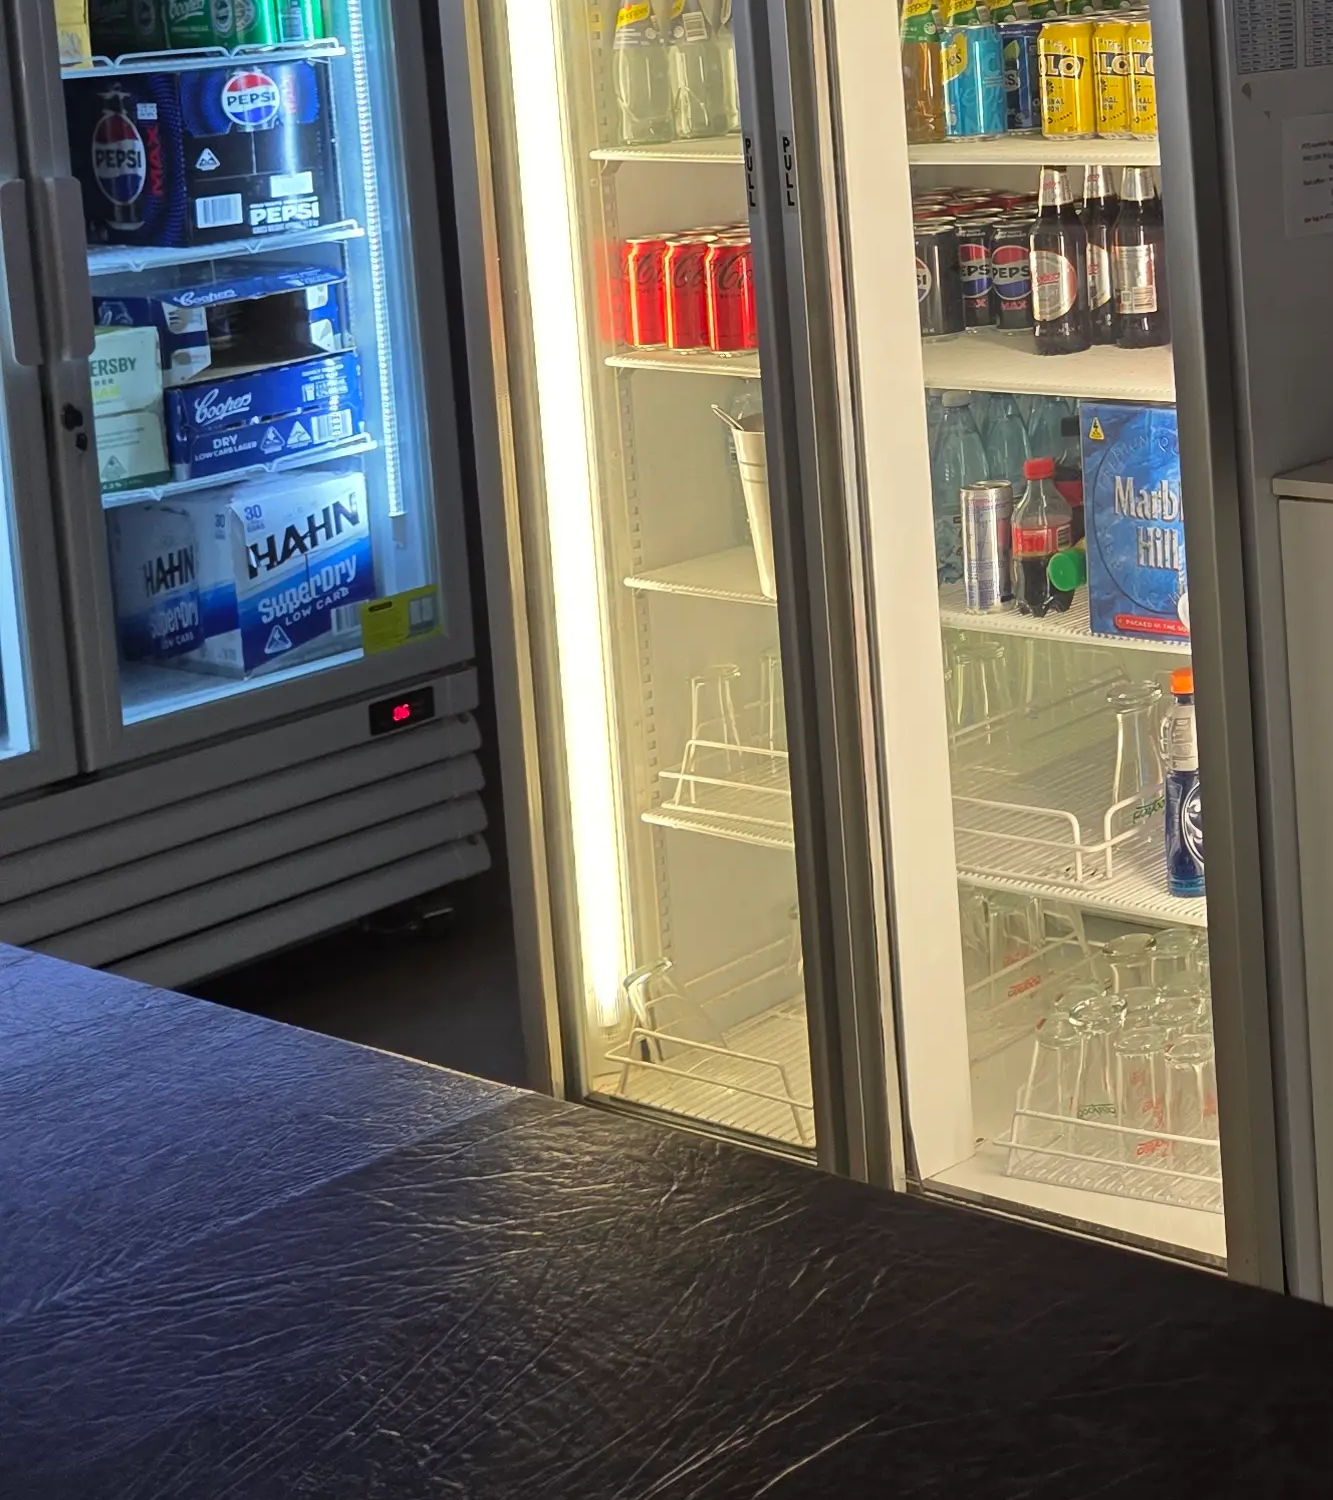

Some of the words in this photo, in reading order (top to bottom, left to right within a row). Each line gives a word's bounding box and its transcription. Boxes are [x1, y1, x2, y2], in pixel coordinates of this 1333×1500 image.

[227, 90, 276, 107] PEPSI
[95, 149, 142, 169] PEPSI
[146, 126, 164, 196] MAX
[743, 137, 757, 208] PULL
[781, 137, 796, 208] PULL
[250, 201, 320, 226] PEPSI
[194, 387, 253, 424] Coopers
[212, 434, 238, 450] DRY
[244, 503, 263, 521] 30
[248, 491, 361, 580] HAHN
[1137, 526, 1180, 570] Hill
[142, 545, 196, 598] HAHN
[257, 554, 357, 625] SuperDry
[284, 607, 312, 627] LOW
[316, 585, 350, 611] CARB
